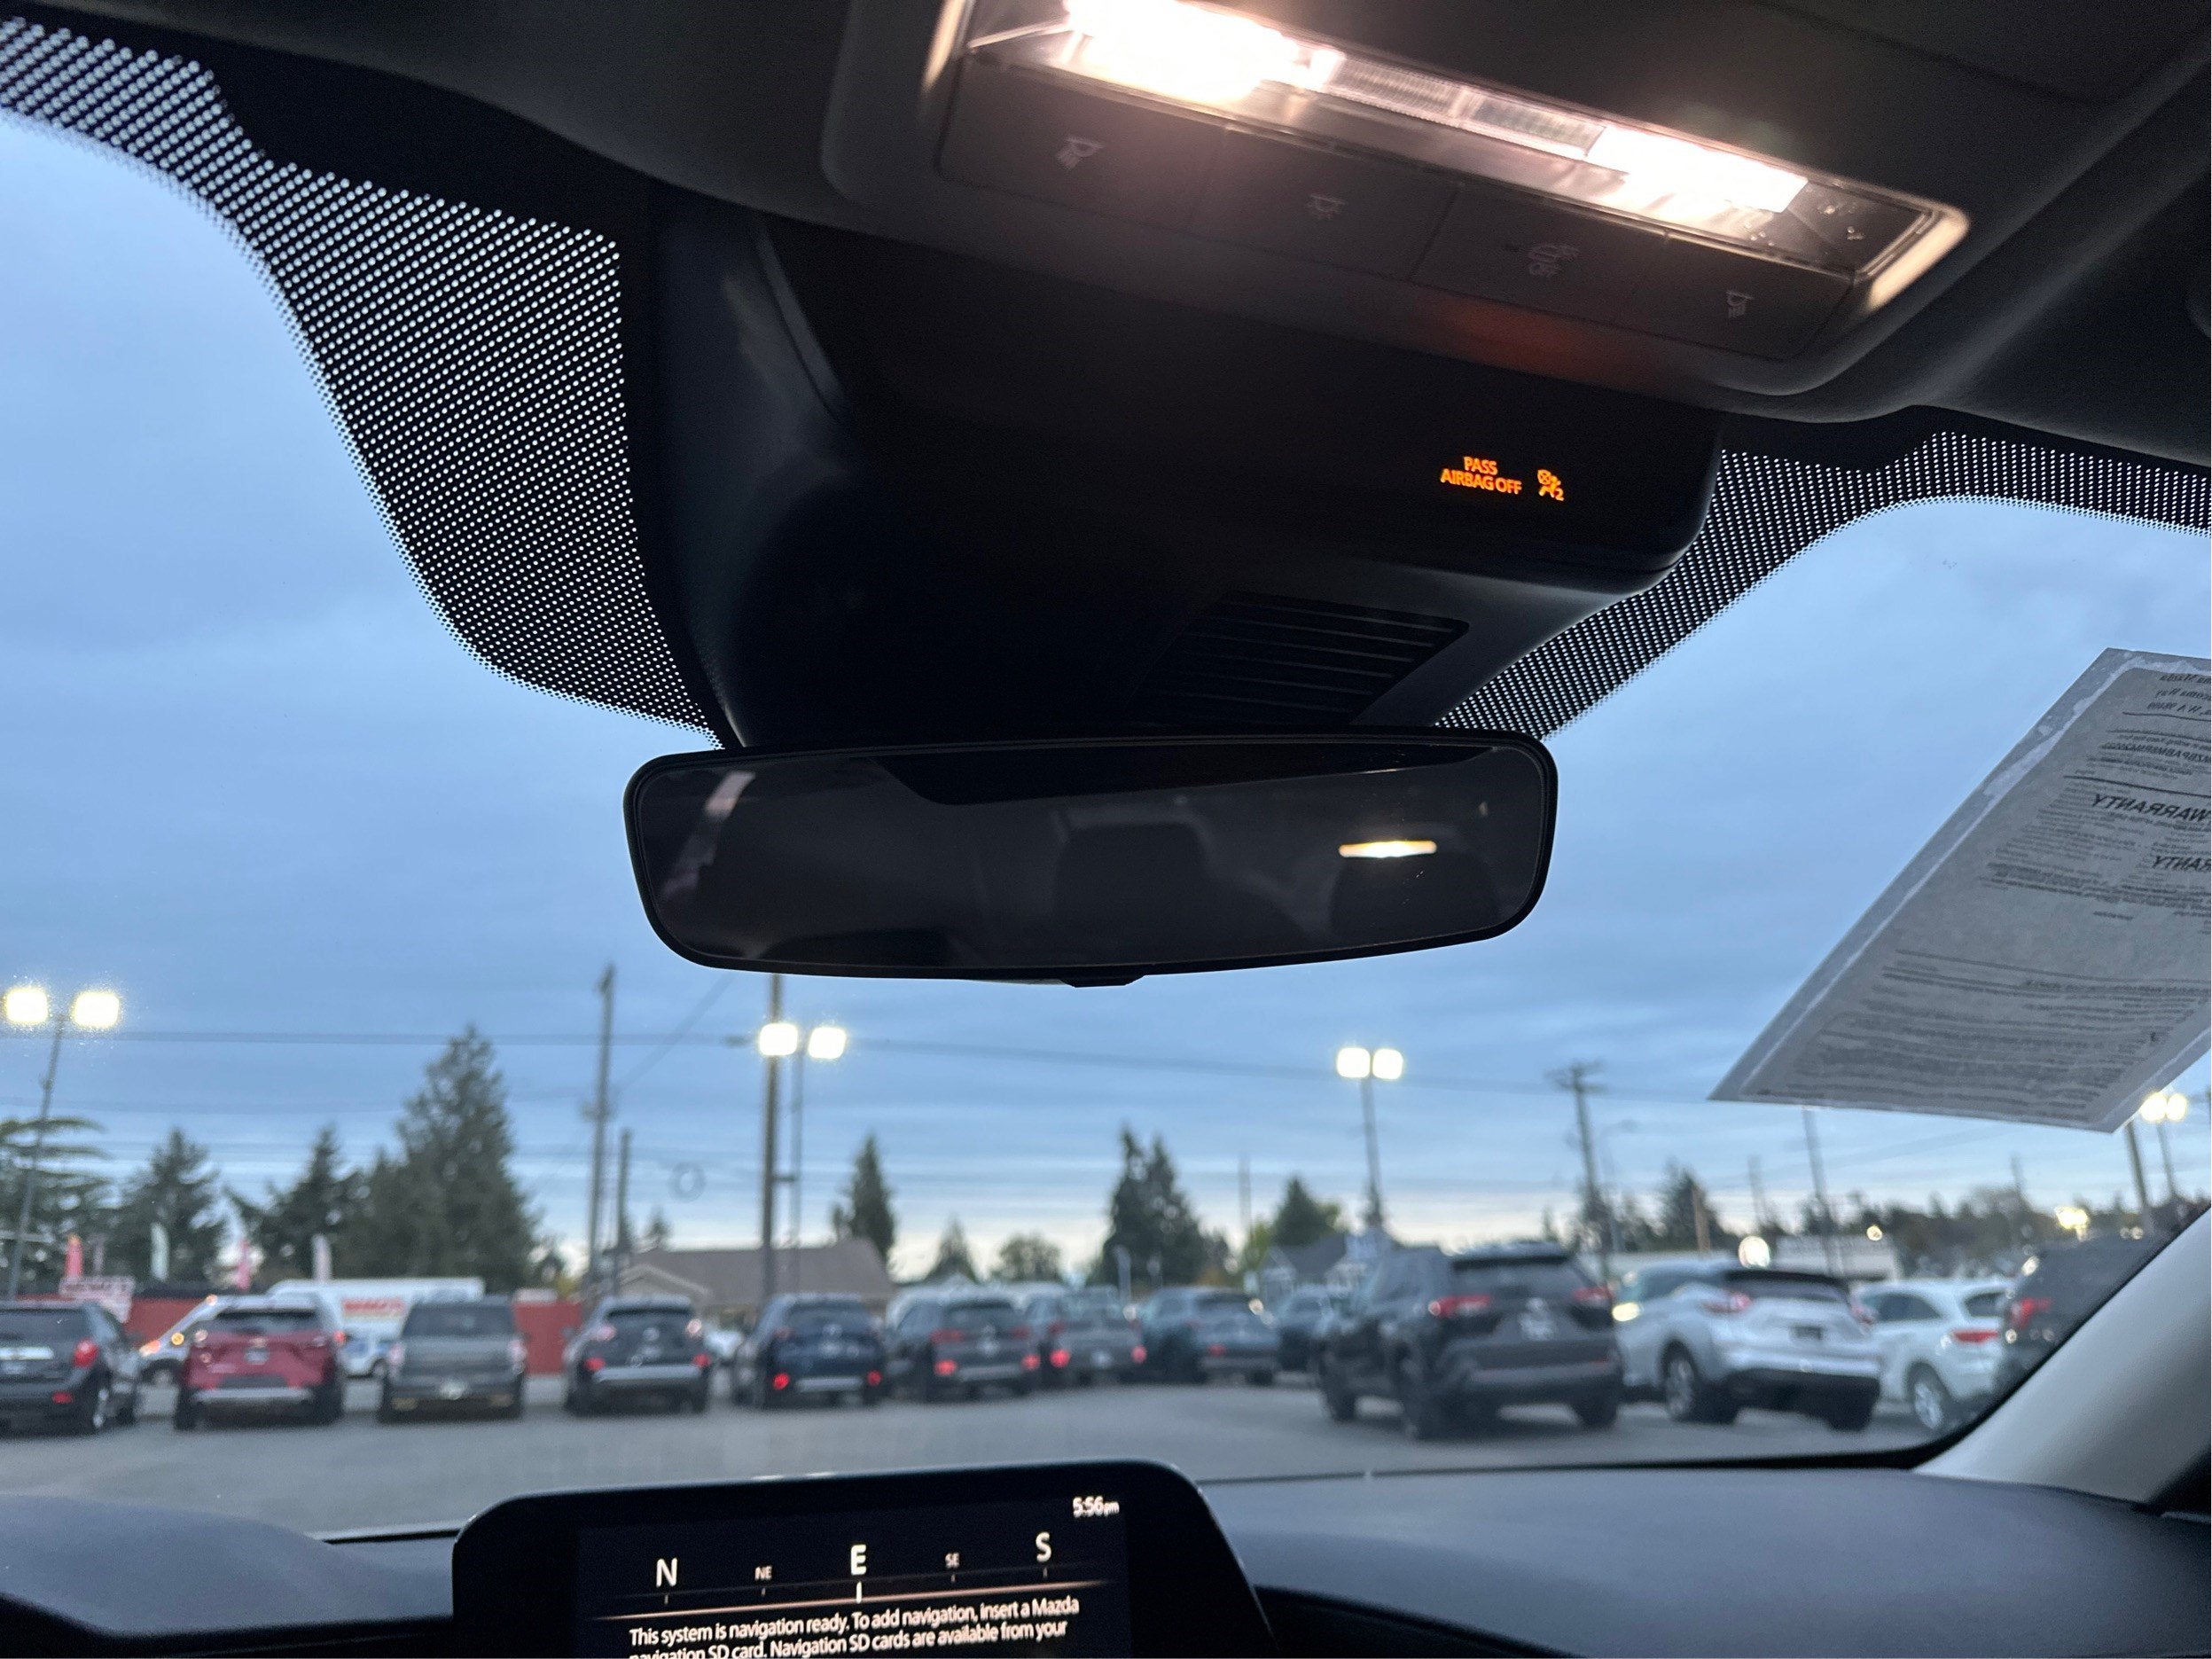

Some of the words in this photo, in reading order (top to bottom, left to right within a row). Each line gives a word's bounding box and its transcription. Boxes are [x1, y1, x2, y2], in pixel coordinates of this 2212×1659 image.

[1440, 468, 1495, 491] AIRBAG
[1495, 477, 1522, 495] OFF
[1463, 456, 1498, 475] PASS
[1073, 1496, 1120, 1518] 5:56pm
[655, 1558, 678, 1588] N
[754, 1566, 772, 1582] NE
[850, 1544, 867, 1576] E
[945, 1553, 960, 1569] SE
[1035, 1531, 1051, 1562] S
[629, 1626, 659, 1647] This
[660, 1626, 713, 1647] system
[715, 1622, 727, 1640] is
[729, 1617, 804, 1643] navigation
[806, 1612, 849, 1636] ready.
[851, 1611, 870, 1631] To
[872, 1608, 900, 1629] add
[902, 1604, 978, 1629] navigation,
[980, 1601, 1019, 1620] insert
[1020, 1602, 1029, 1616] a
[1031, 1595, 1080, 1617] Mazda
[707, 1644, 729, 1659] SD
[731, 1640, 768, 1659] card.
[770, 1636, 848, 1658] Navigation
[849, 1632, 871, 1654] SD
[872, 1630, 911, 1651] cards
[911, 1632, 935, 1647] are
[937, 1623, 999, 1646] available
[1000, 1621, 1034, 1639] from
[1036, 1621, 1067, 1642] your
